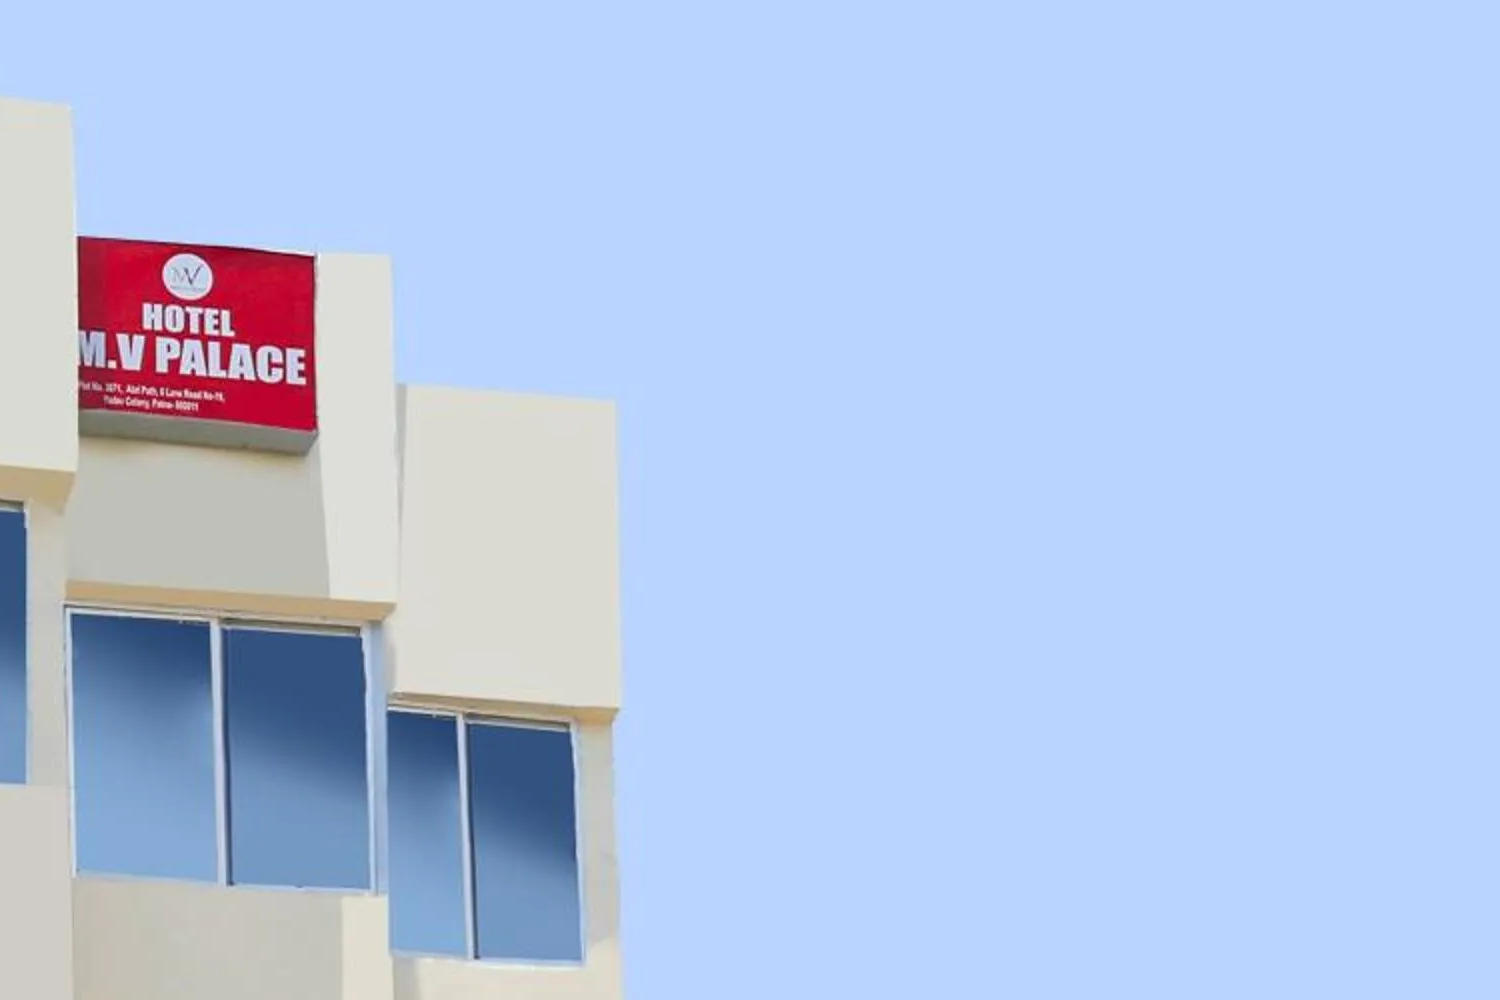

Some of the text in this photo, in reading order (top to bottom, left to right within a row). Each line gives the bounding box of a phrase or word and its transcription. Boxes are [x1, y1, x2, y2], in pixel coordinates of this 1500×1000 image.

[142, 302, 235, 337] HOTEL
[78, 329, 307, 385] M.V PALACE
